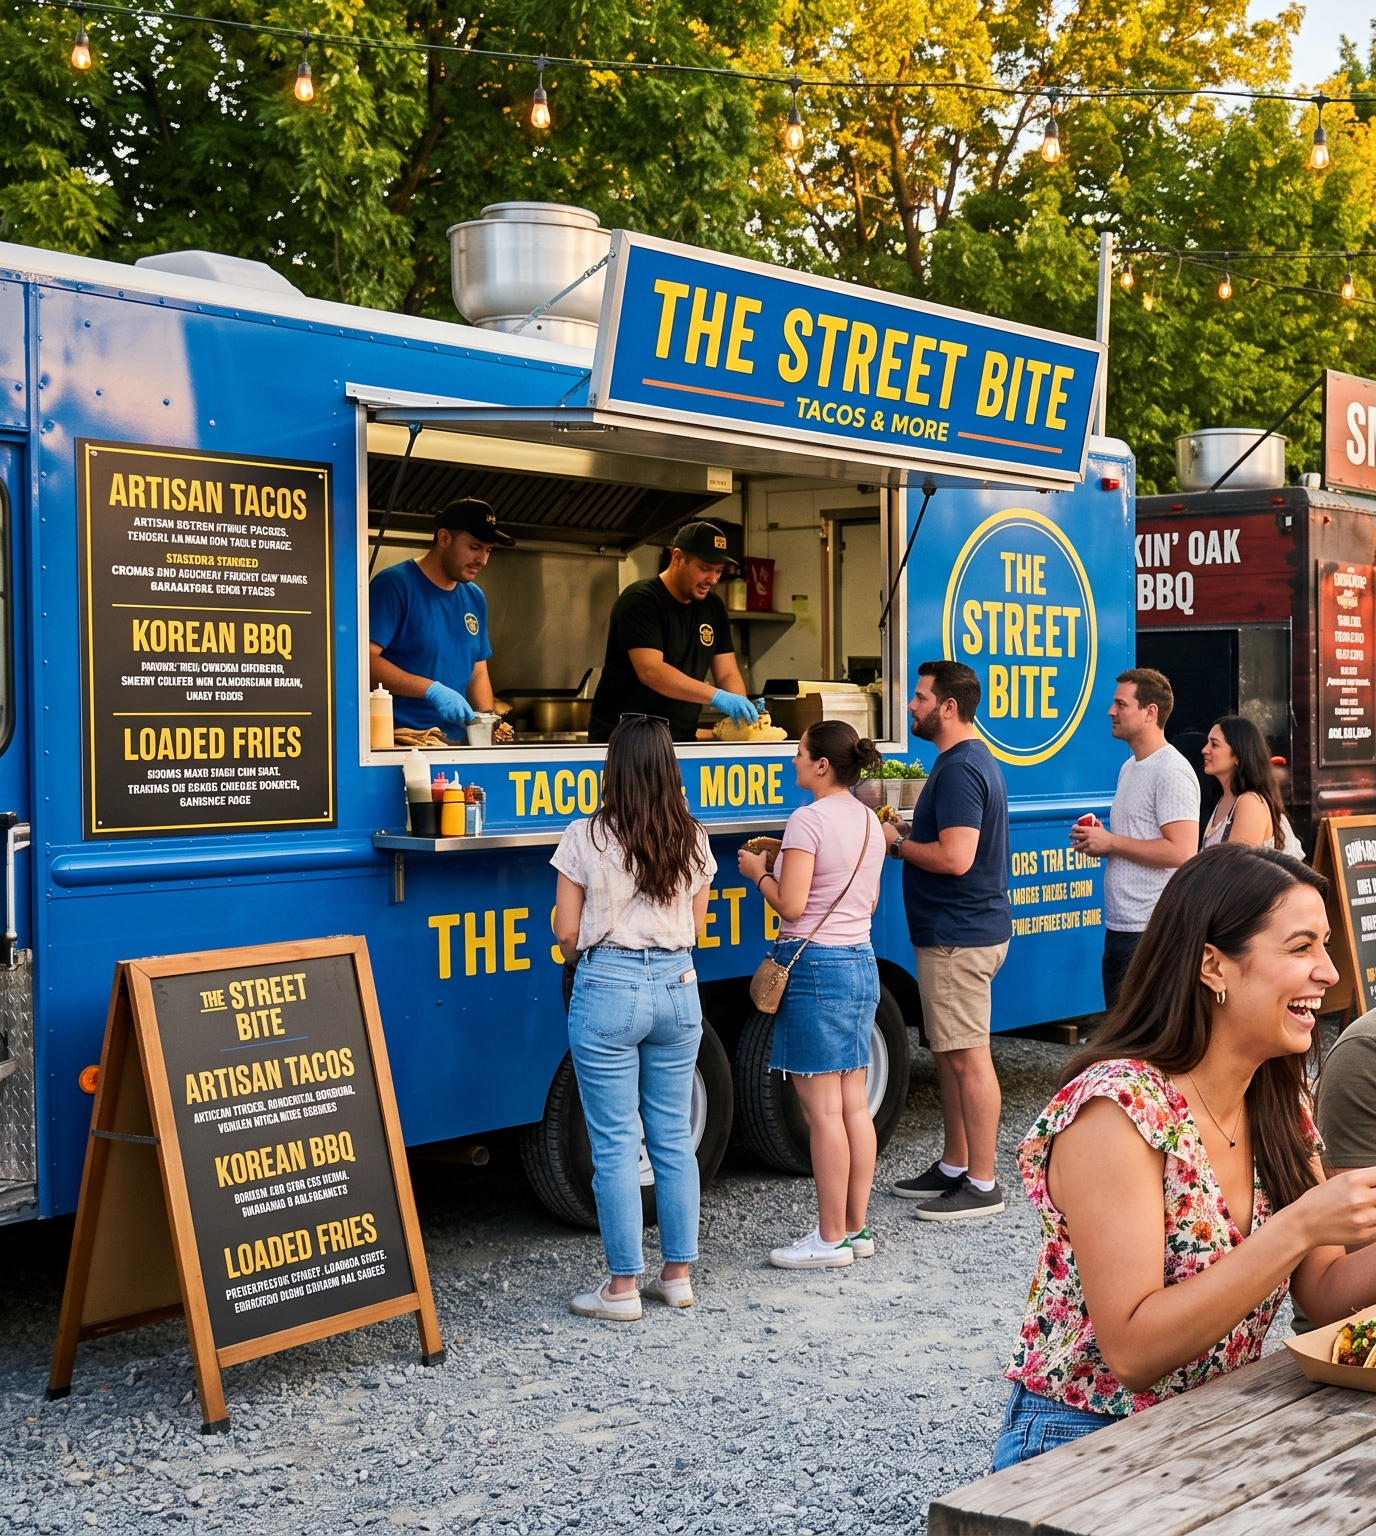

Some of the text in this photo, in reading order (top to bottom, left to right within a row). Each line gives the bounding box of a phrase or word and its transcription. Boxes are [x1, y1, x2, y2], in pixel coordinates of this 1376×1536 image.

[653, 278, 1075, 432] THE STREET BITE
[797, 397, 950, 442] TACOS & MORE
[109, 473, 307, 521] ARTISAN TACOS
[1188, 528, 1241, 566] OAK
[1000, 551, 1047, 596] THE
[1137, 571, 1194, 615] BBQ
[132, 619, 292, 660] KOREAN BBQ
[962, 599, 1081, 658] STREET
[988, 664, 1059, 719] BITE
[124, 726, 302, 761] LOADED FRIES
[508, 763, 784, 817] TACO MORE
[428, 907, 531, 980] THE
[200, 973, 307, 1010] THE STREET
[235, 1007, 286, 1041] BITE
[185, 1059, 283, 1105] ARTISAN
[284, 1047, 355, 1086] TACOS
[214, 1140, 307, 1188] KOREAN
[309, 1130, 356, 1167] BBQ
[223, 1229, 313, 1279] LOADED
[316, 1213, 378, 1255] FRIES
